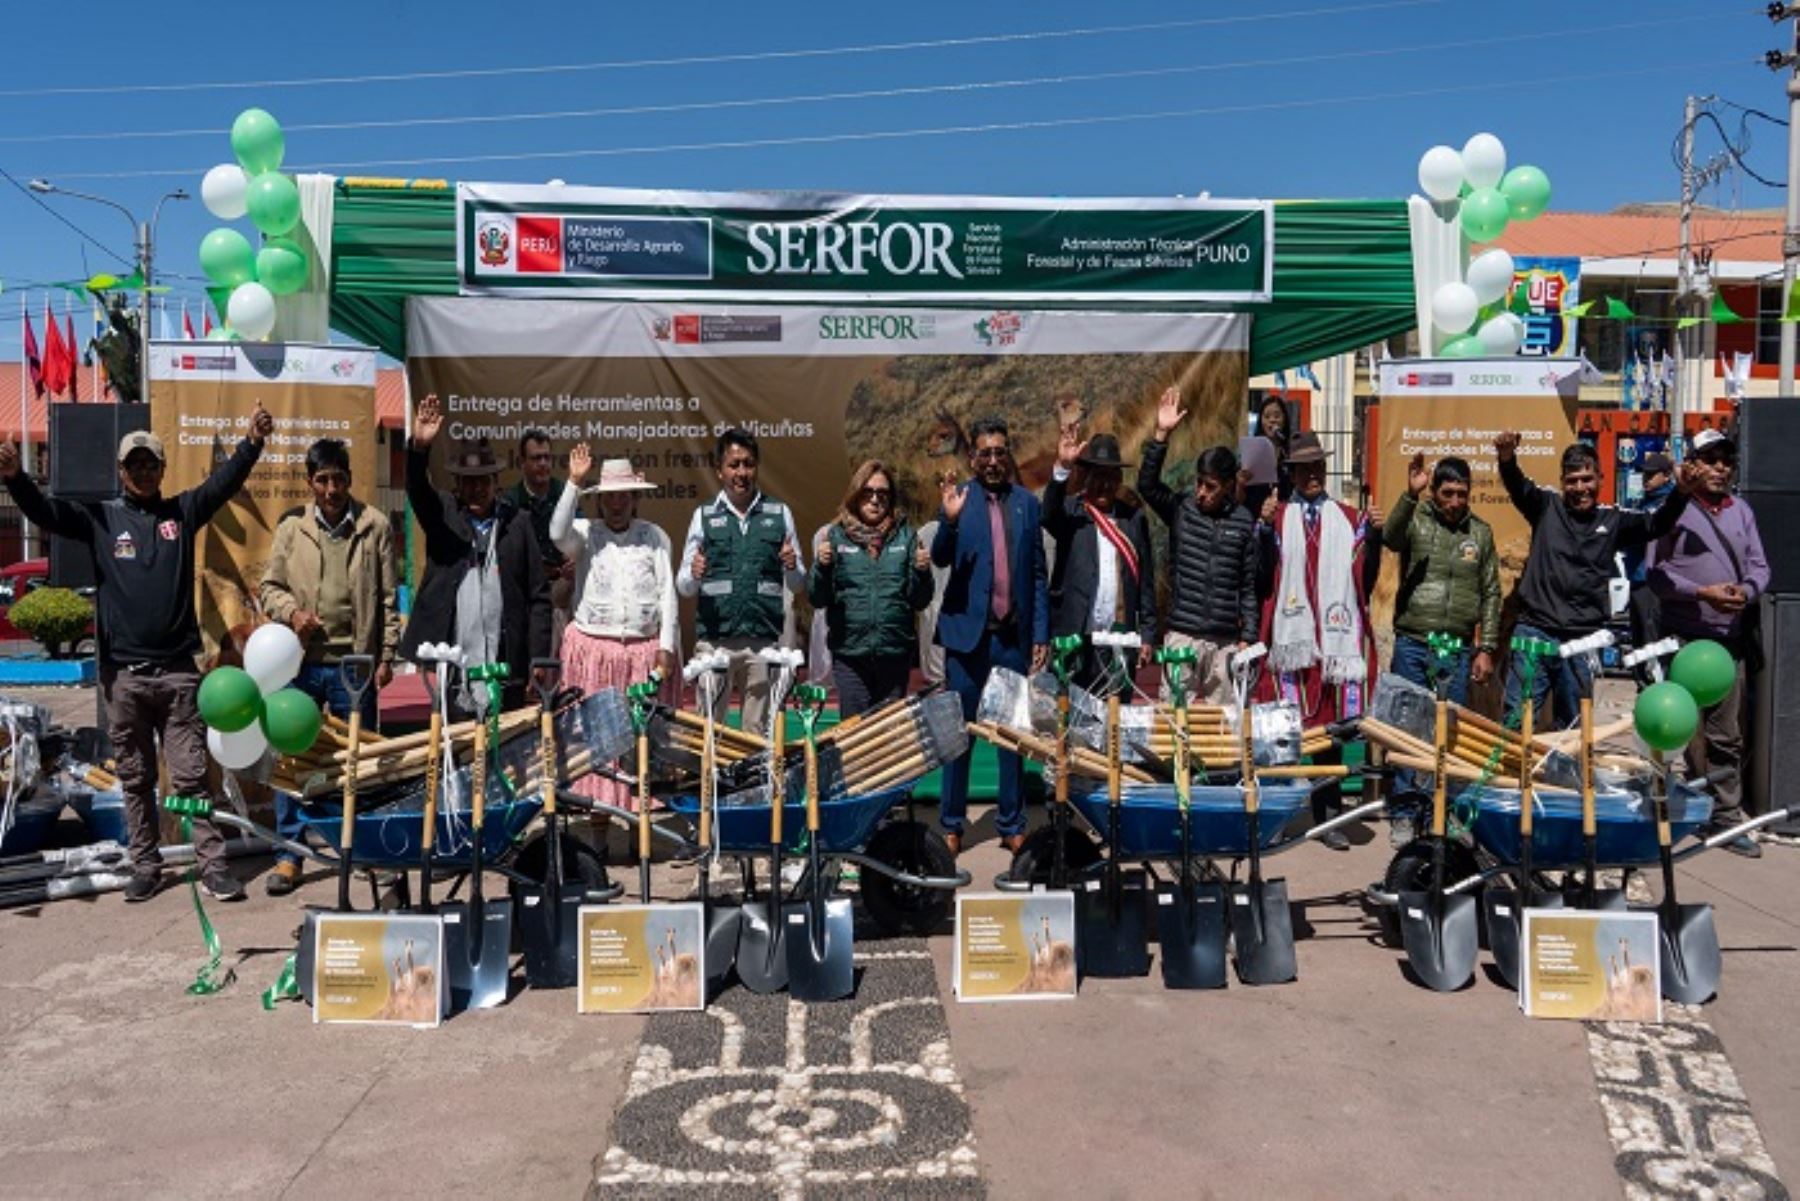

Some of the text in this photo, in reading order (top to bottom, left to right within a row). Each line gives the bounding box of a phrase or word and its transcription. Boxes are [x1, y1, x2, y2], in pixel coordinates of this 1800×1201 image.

[568, 225, 624, 238] Ministerio
[568, 239, 684, 255] de Desarrollo Agrario
[747, 222, 964, 279] SERFOR
[1061, 236, 1195, 251] Administración Técnica
[568, 256, 575, 268] y
[1027, 253, 1194, 271] Forestal y de Fauna Silvestre
[1197, 244, 1249, 263] PUNO
[819, 315, 917, 339] SERFOR
[448, 394, 700, 416] Entrega de Herramientas a
[180, 416, 231, 431] Entrega
[341, 420, 350, 429] a
[587, 420, 707, 441] Manejadoras
[1403, 426, 1447, 441] Entrega
[1449, 428, 1462, 439] de
[1546, 431, 1553, 439] a
